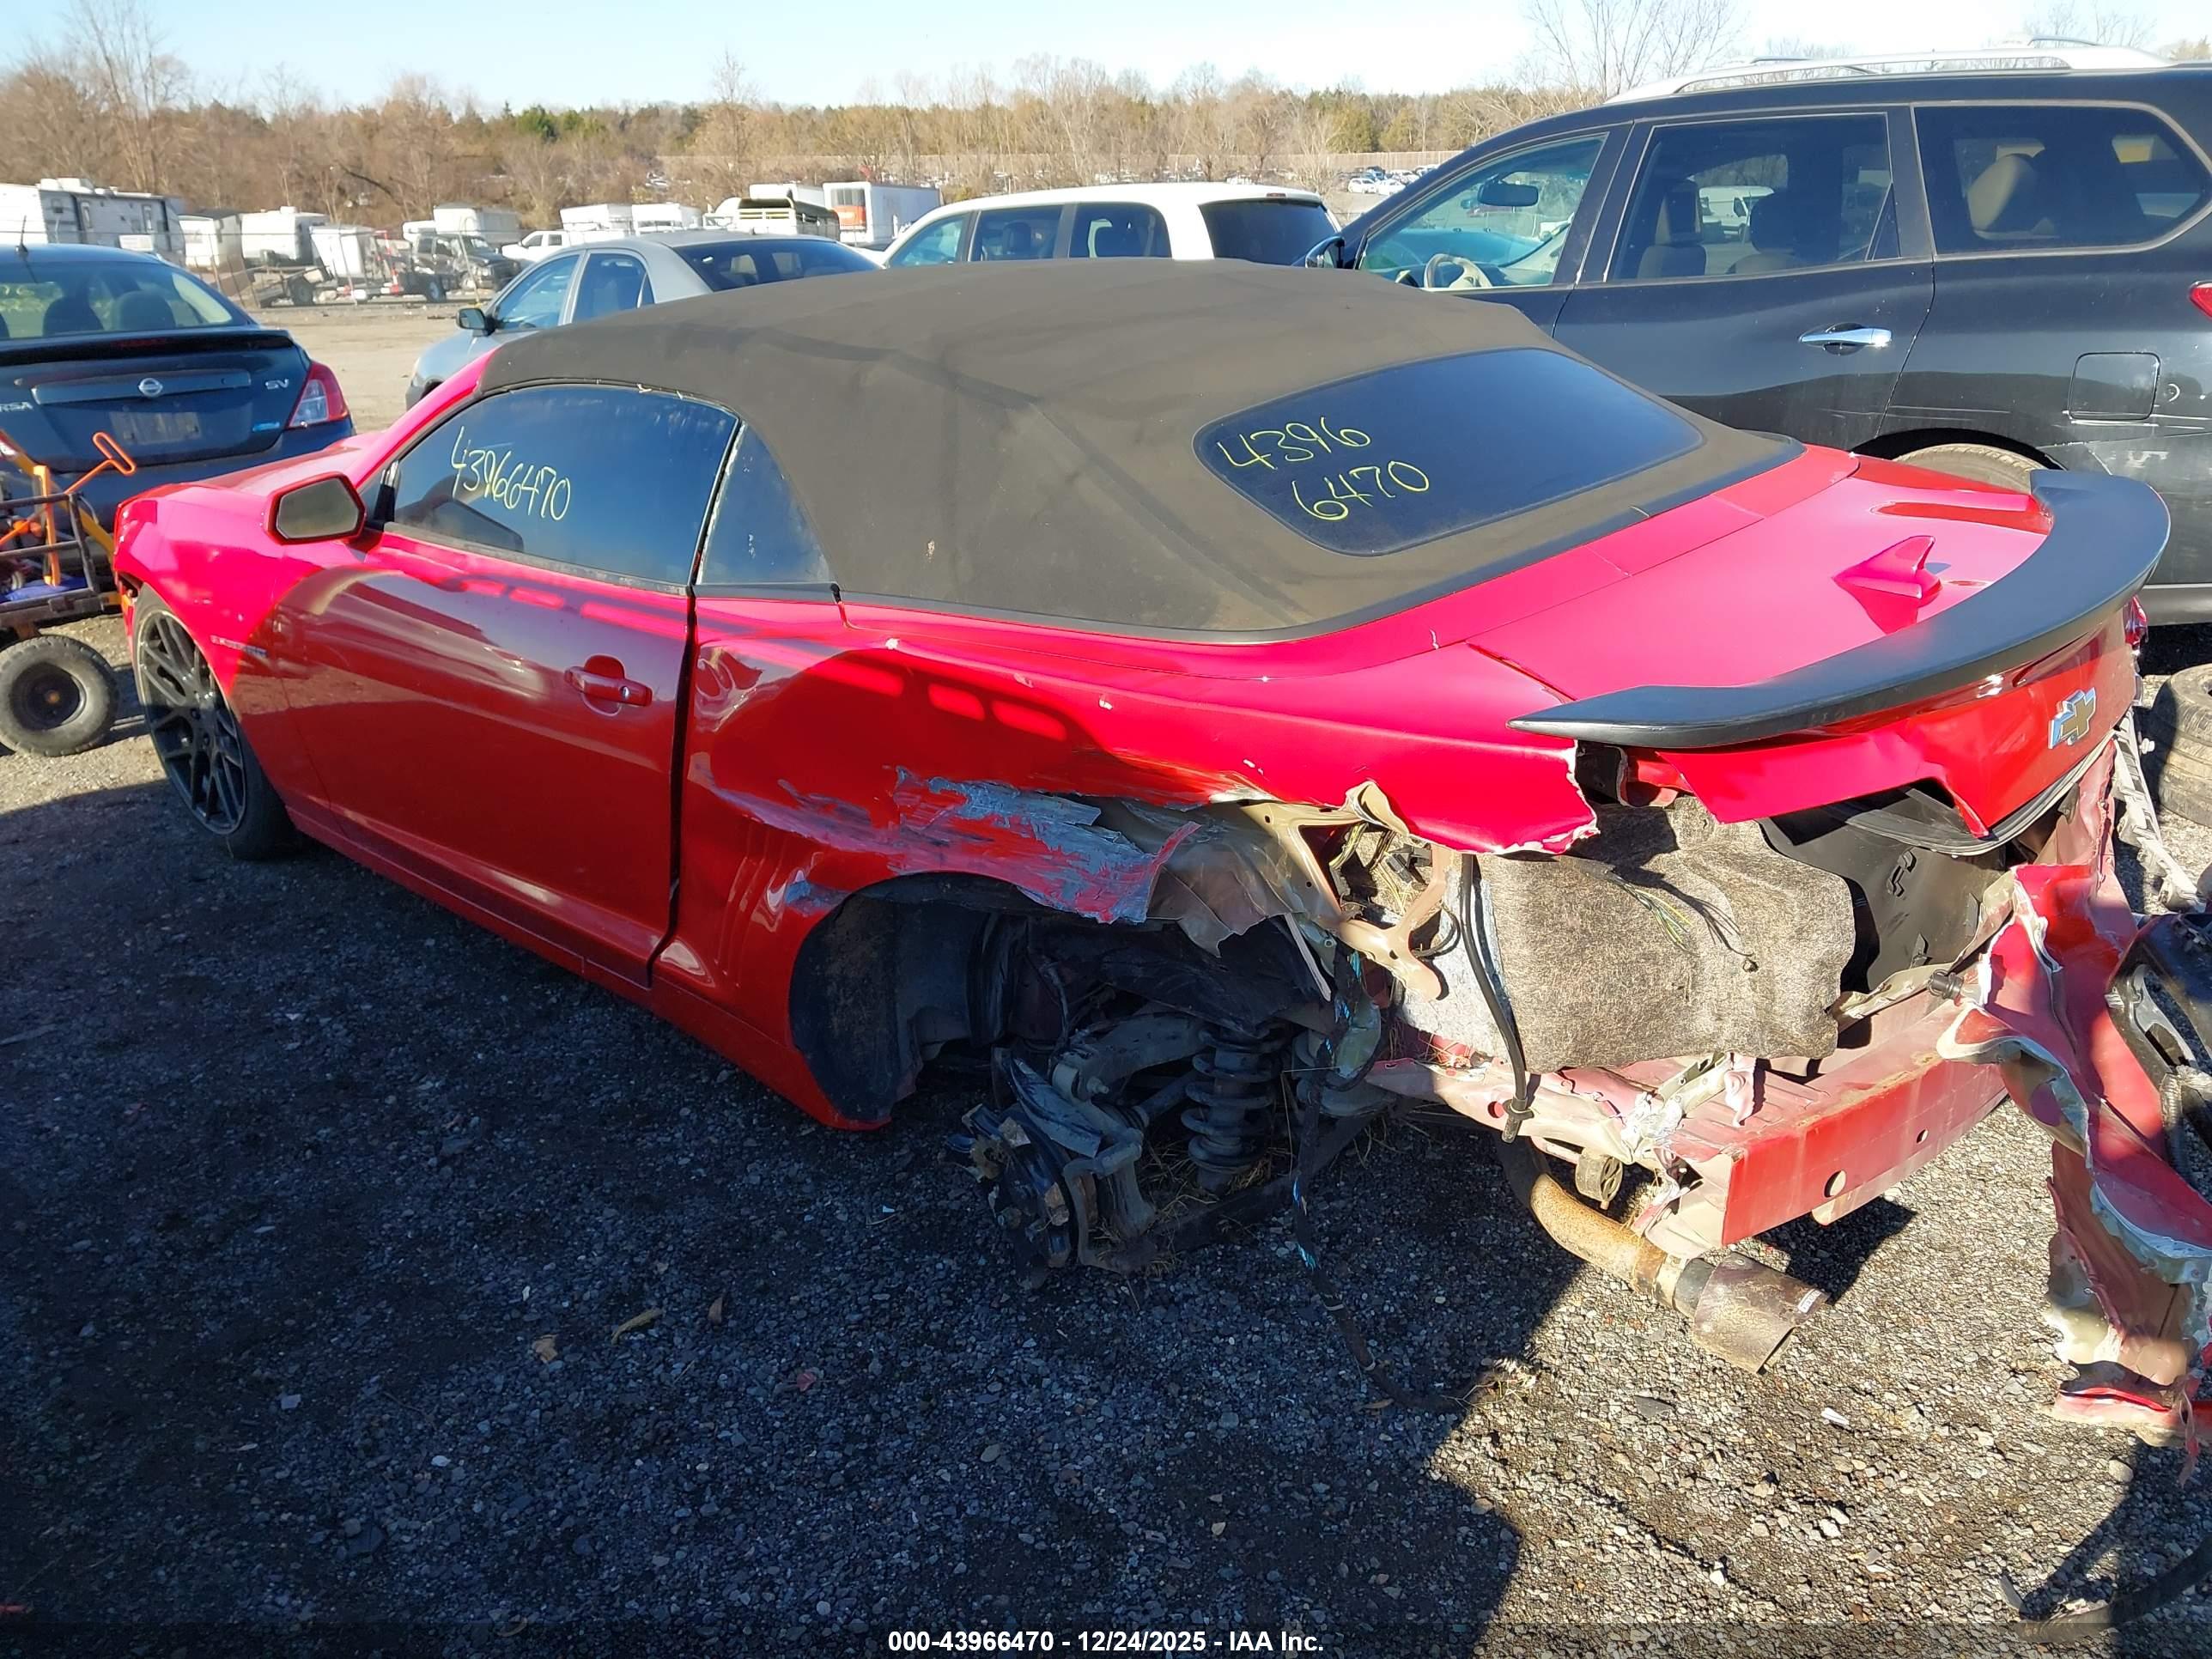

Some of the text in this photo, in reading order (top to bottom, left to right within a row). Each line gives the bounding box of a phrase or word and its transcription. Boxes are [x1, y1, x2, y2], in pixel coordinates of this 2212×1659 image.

[264, 379, 289, 390] SV
[451, 425, 571, 520] 43966470
[1216, 416, 1372, 471] 4396
[1291, 459, 1430, 521] 6470
